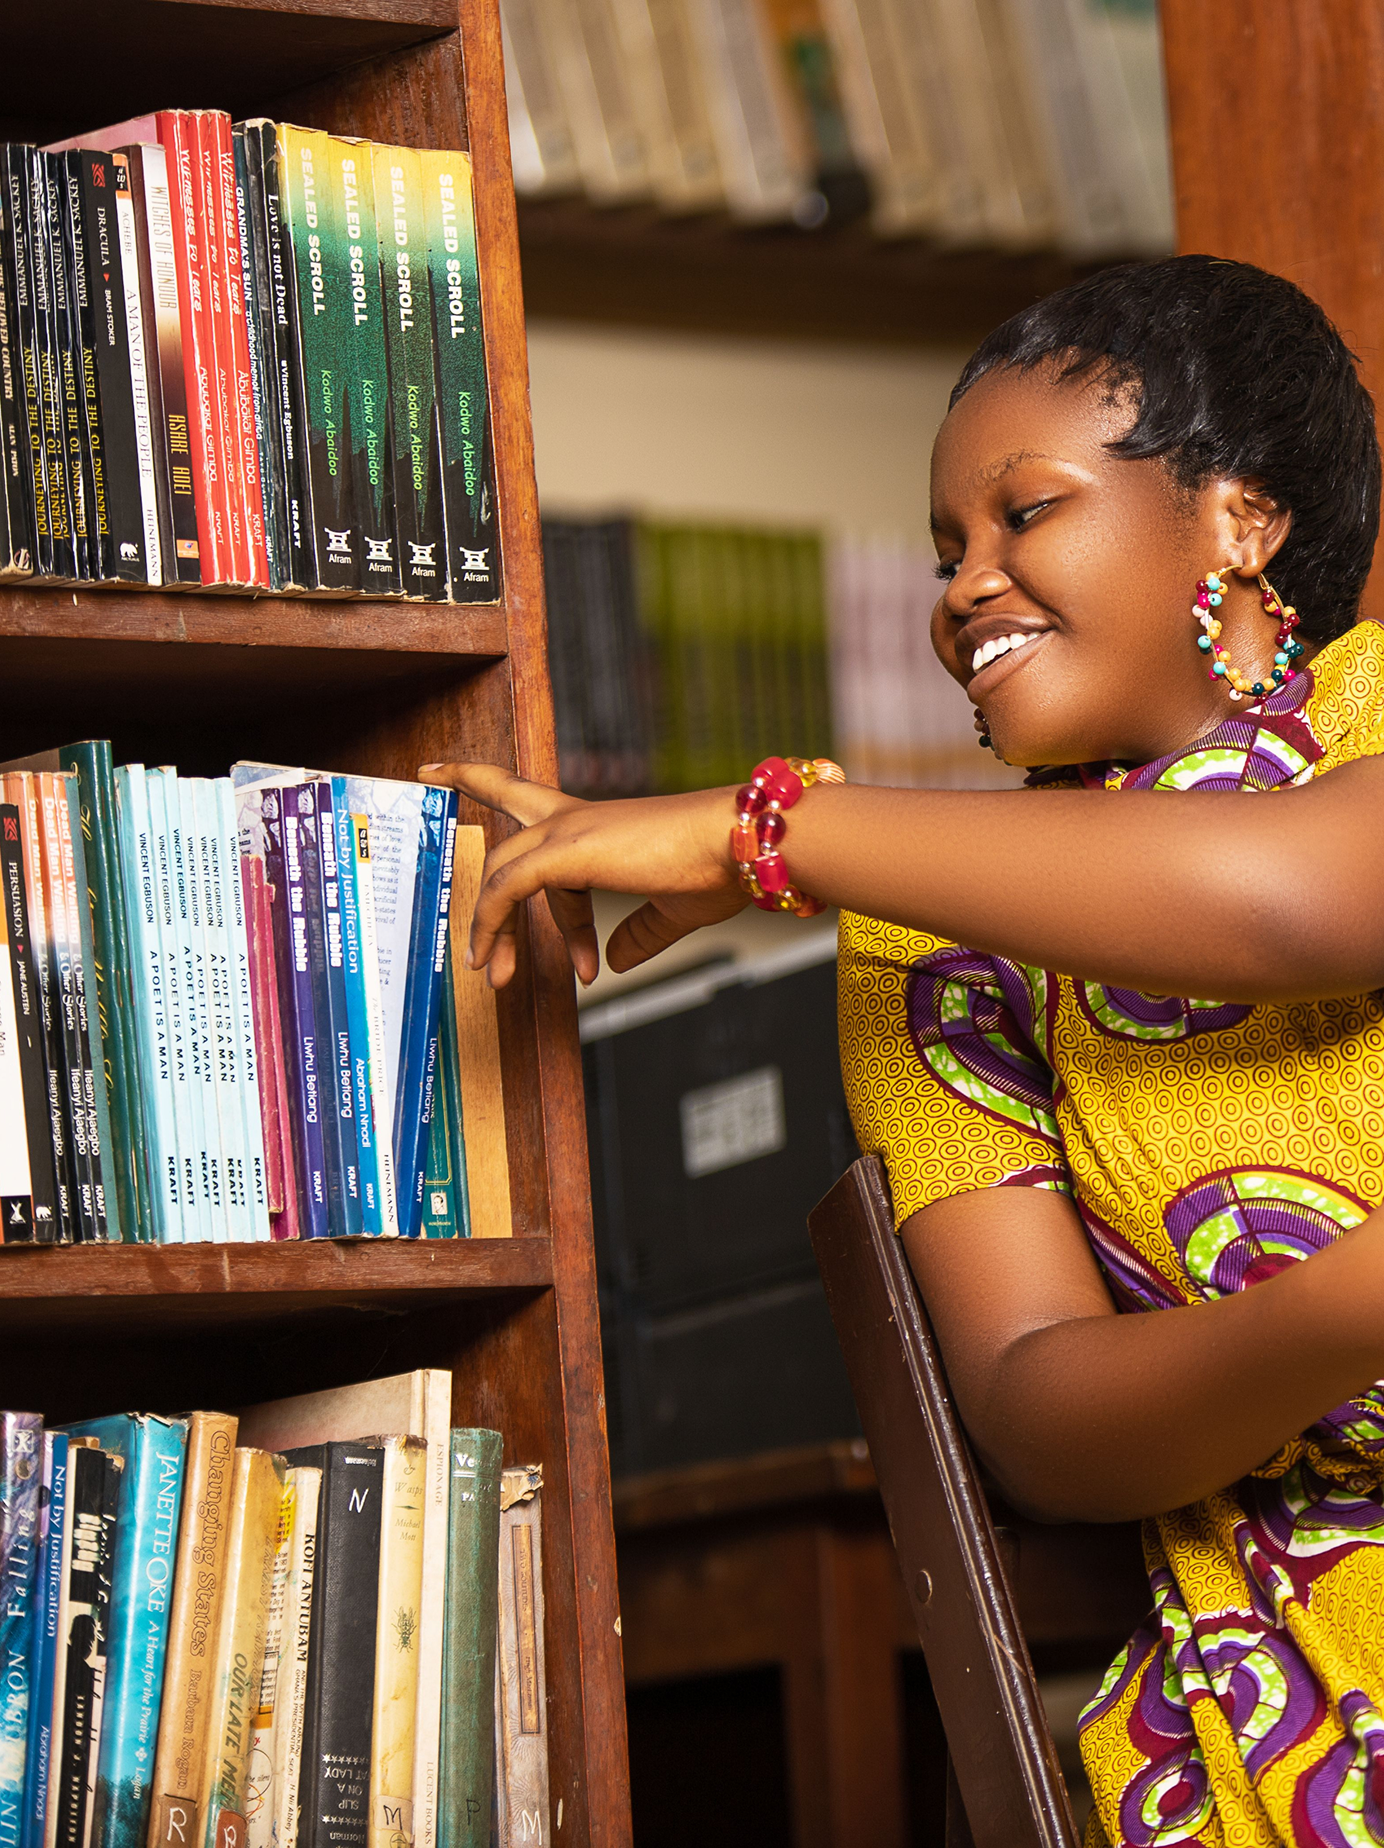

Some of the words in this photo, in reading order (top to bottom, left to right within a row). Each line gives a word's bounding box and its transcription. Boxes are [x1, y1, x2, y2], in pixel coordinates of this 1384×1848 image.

[221, 152, 236, 240] Witnesses
[300, 147, 318, 229] SEALED
[342, 159, 361, 239] SEALED
[390, 166, 408, 246] SEALED
[151, 186, 170, 236] WITCHES
[235, 186, 250, 269] GRANDMA'S
[268, 194, 279, 235] Love
[439, 174, 458, 253] SEALED
[97, 206, 110, 266] DRACULA
[122, 211, 132, 256] ACHEBE
[154, 243, 173, 257] OF
[272, 238, 280, 250] is
[228, 247, 239, 266] to
[273, 254, 284, 280] not
[308, 234, 325, 316] SCROLL
[104, 290, 112, 313] BRAM
[127, 290, 136, 300] A
[157, 260, 177, 310] HONOUR
[230, 274, 242, 316] Tears
[243, 272, 252, 300] SUN
[349, 245, 368, 326] SCROLL
[396, 252, 414, 332] SCROLL
[446, 259, 465, 339] SCROLL
[129, 306, 141, 343] MAN
[276, 285, 289, 325] Dead
[106, 314, 116, 346] STOKER
[84, 348, 96, 398] DESTINY
[132, 348, 143, 372] OF
[250, 360, 260, 391] memoir
[134, 374, 145, 409] THE
[238, 370, 253, 434] Abubakar
[252, 392, 263, 413] from
[321, 370, 333, 414] Kodwo
[362, 380, 373, 423] Kodwo
[407, 385, 419, 429] Kodwo
[88, 404, 97, 426] THE
[254, 414, 265, 440] africa
[458, 391, 470, 435] Kodwo
[92, 435, 100, 450] TO
[136, 414, 152, 478] PEOPLE
[168, 414, 189, 455] ASARE
[284, 412, 294, 460] Egbuson
[325, 419, 337, 476] Abaidoo
[244, 437, 256, 484] Gimba
[366, 428, 379, 485] Abaidoo
[410, 434, 422, 490] Abaidoo
[462, 439, 475, 496] Abaidoo
[95, 459, 110, 534] JOURNEYING
[172, 466, 192, 495] ADEI
[147, 508, 158, 578] HEINEMANN
[252, 513, 262, 547] KRAFT
[291, 500, 301, 549] KRAFT
[329, 554, 351, 564] Afram
[369, 562, 392, 572] Afram
[412, 567, 436, 577] Afram
[464, 572, 489, 582] Afram
[45, 798, 56, 838] Dead
[338, 809, 348, 839] Not
[50, 840, 60, 876] Man
[139, 833, 150, 874] VINCENT
[321, 812, 337, 877] Beneath
[339, 845, 352, 868] by
[9, 862, 24, 937] PERSUASION
[53, 880, 67, 943] Walking
[142, 877, 154, 924] EGBUSON
[326, 882, 338, 908] the
[328, 912, 343, 968] Rubble
[343, 871, 359, 974] Justification
[17, 960, 27, 981] JANE
[150, 951, 158, 960] A
[60, 962, 72, 993] Other
[151, 965, 162, 1006] POET
[20, 982, 30, 1015] AUSTEN
[62, 994, 74, 1030] Stories
[156, 1011, 164, 1026] IS
[157, 1032, 165, 1041] A
[158, 1046, 168, 1079] MAN
[338, 1032, 349, 1066] Liwhu
[71, 1068, 84, 1106] Ifeanyi
[341, 1070, 352, 1118] Betiang
[356, 1058, 367, 1111] Abraham
[74, 1108, 86, 1156] Ajaegbo
[360, 1114, 371, 1148] Nnadi
[167, 1156, 178, 1205] KRAFT
[347, 1166, 357, 1198] KRAFT
[384, 1154, 394, 1223] HEINEMANN
[82, 1185, 93, 1218] KRAFT
[395, 1482, 423, 1494] Wasps
[436, 1444, 444, 1506] ESPIONAGE
[153, 1452, 179, 1555] JANETTE
[192, 1431, 230, 1567] Changing
[349, 1488, 369, 1513] N
[395, 1518, 420, 1528] Michael
[400, 1532, 417, 1540] Mott
[7, 1508, 35, 1618] Falling
[302, 1534, 315, 1573] KOFI
[145, 1557, 170, 1613] OKE
[148, 1620, 159, 1633] A
[190, 1571, 217, 1658] States
[296, 1581, 312, 1662] ANTUBAM
[145, 1636, 159, 1669] Heart
[141, 1669, 156, 1685] for
[142, 1687, 153, 1704] the
[230, 1653, 248, 1699] OUR
[184, 1669, 202, 1734] Barbara
[138, 1706, 151, 1744] Prairie
[225, 1701, 242, 1754] LATE
[131, 1767, 145, 1799] Logan
[175, 1737, 194, 1790] Rogan
[324, 1767, 352, 1779] LADY
[356, 1769, 369, 1780] AT
[337, 1784, 345, 1794] A
[339, 1800, 358, 1810] SLIP
[348, 1784, 362, 1795] ON
[166, 1807, 187, 1843] R
[383, 1804, 403, 1830] M
[425, 1809, 433, 1845] BOOKS
[466, 1798, 481, 1825] P
[521, 1810, 542, 1845] M
